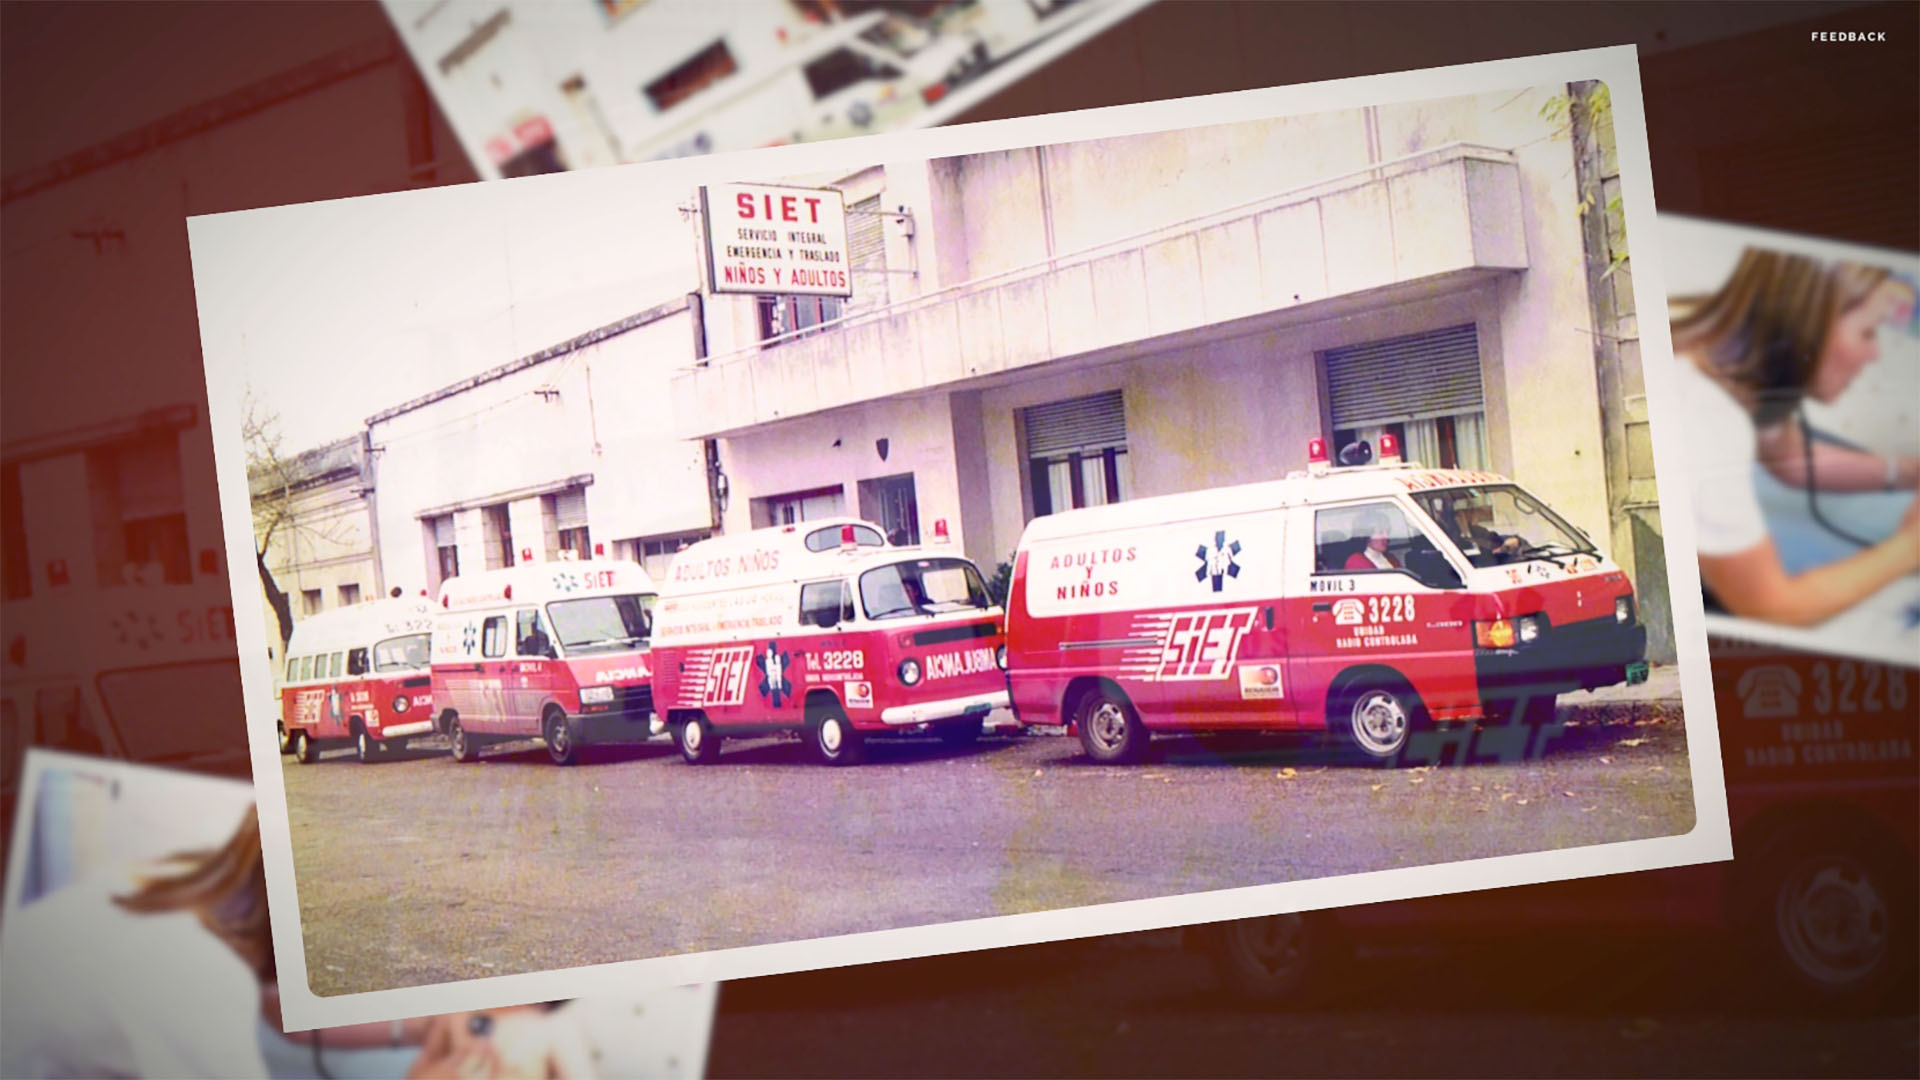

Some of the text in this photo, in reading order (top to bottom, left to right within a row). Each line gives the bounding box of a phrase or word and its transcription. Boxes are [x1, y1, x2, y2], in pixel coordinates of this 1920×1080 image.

[736, 192, 821, 224] SIET
[738, 228, 827, 245] SERVICIO INTEGRAL
[727, 245, 840, 263] EMERGENCIA Y TRASLADO
[724, 262, 846, 288] NIÑOS Y ADULTOS
[738, 549, 780, 574] NIÑOS
[1050, 547, 1137, 570] ADULTOS
[584, 570, 614, 589] SIET
[1085, 566, 1093, 579] Y
[1056, 580, 1119, 600] NIÑOS
[1310, 579, 1355, 592] MOVIL 3
[1368, 594, 1415, 623] 3228
[1155, 606, 1259, 682] SIET
[1364, 634, 1418, 648] CONTROLADA
[823, 650, 863, 670] 3228
[703, 646, 754, 706] SIET
